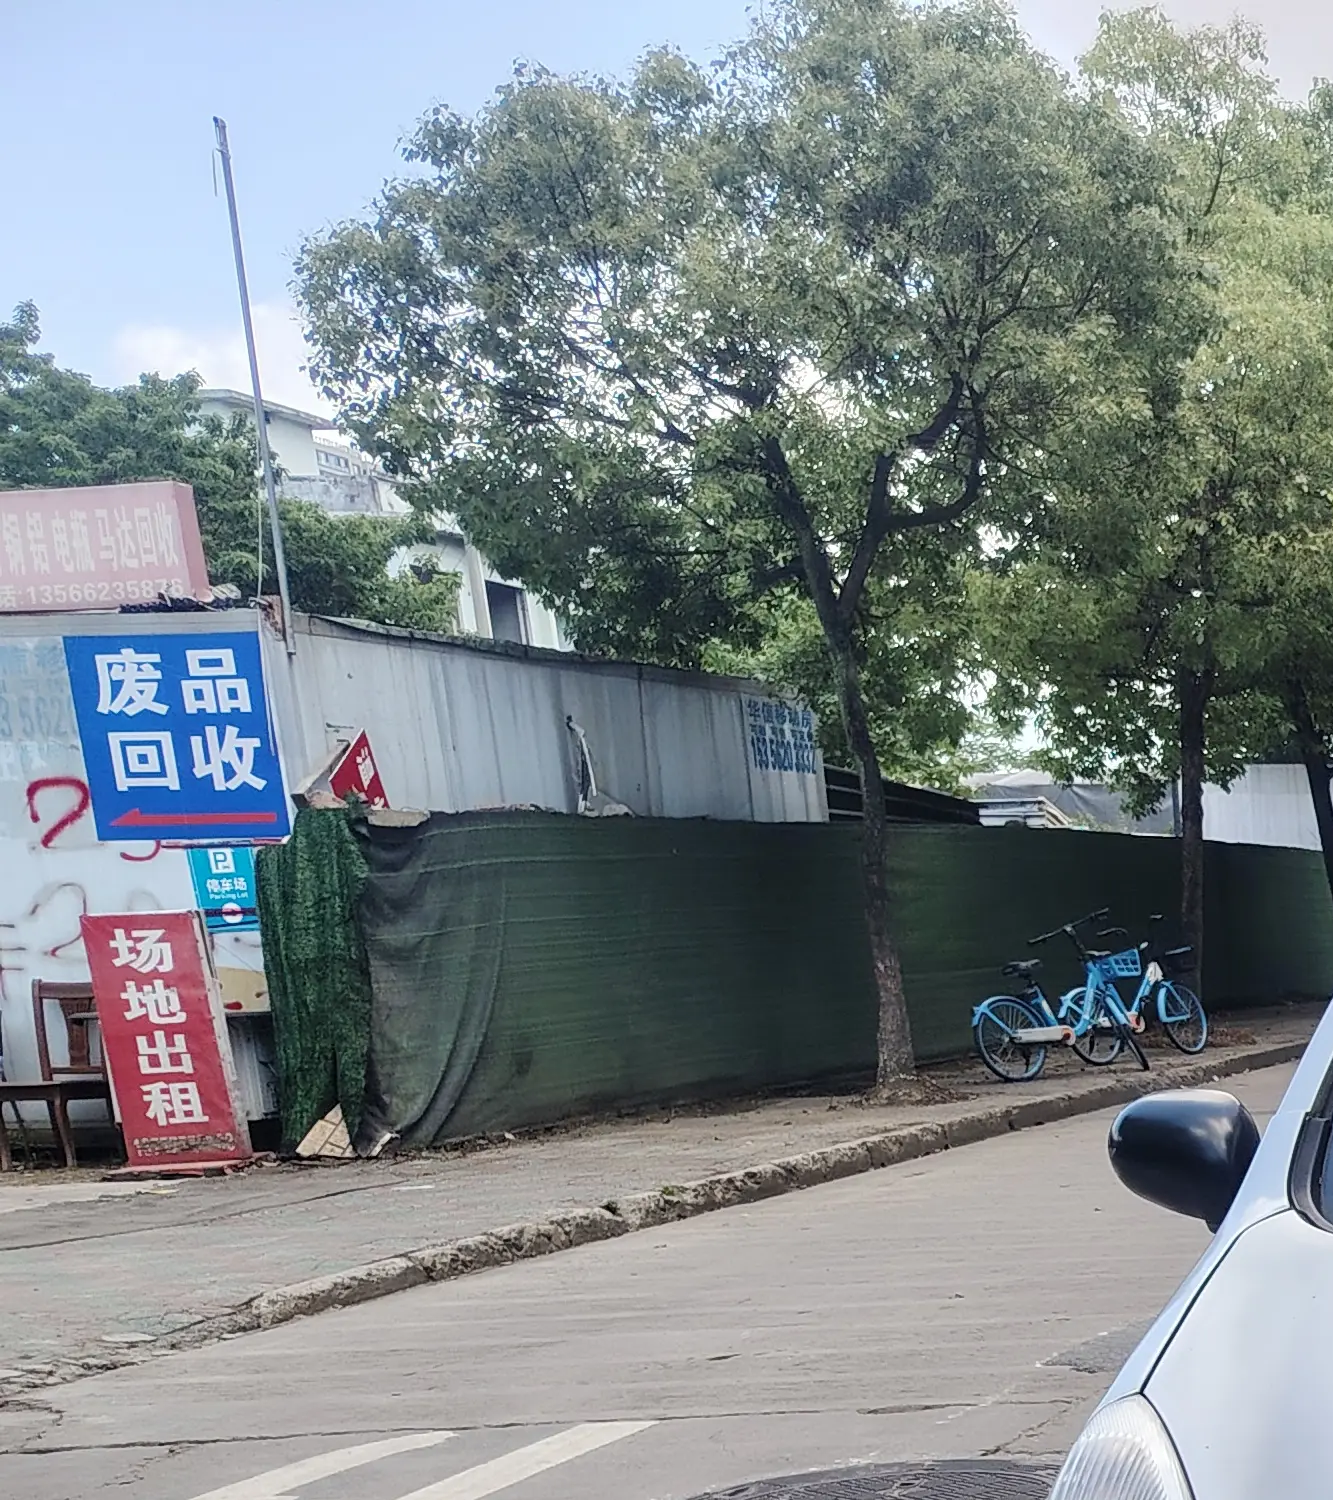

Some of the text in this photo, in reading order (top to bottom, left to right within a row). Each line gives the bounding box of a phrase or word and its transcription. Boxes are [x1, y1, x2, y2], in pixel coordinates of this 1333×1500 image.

[95, 647, 252, 716] 废品
[107, 725, 268, 792] 回收
[206, 876, 248, 893] 停车场
[109, 928, 209, 1126] 场地出租
